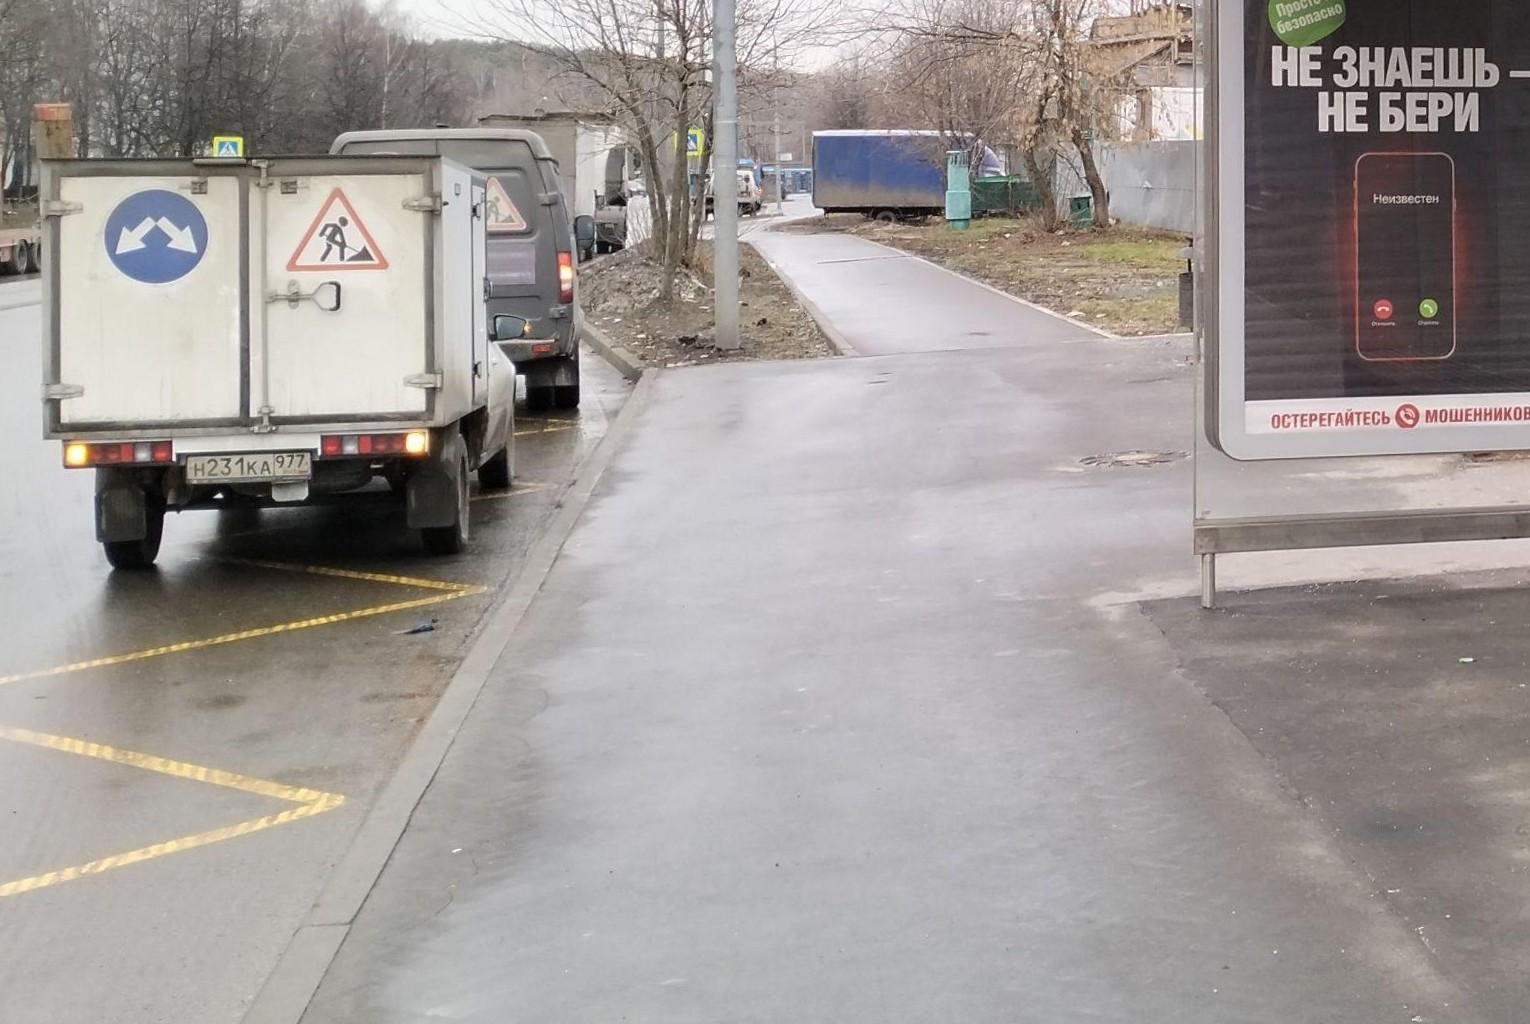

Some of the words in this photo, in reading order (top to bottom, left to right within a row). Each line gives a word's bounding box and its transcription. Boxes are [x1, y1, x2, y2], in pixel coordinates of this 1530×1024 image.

[1276, 3, 1343, 35] безопасно
[1271, 45, 1323, 87] НЕ
[1332, 45, 1500, 88] ЗНАЕШЬ
[1317, 91, 1369, 133] НЕ
[1379, 91, 1480, 133] БЕРИ
[1373, 193, 1440, 205] Неизвестен
[1271, 409, 1391, 429] ОСТЕРЕГАЙТЕСЬ
[275, 454, 305, 469] 977
